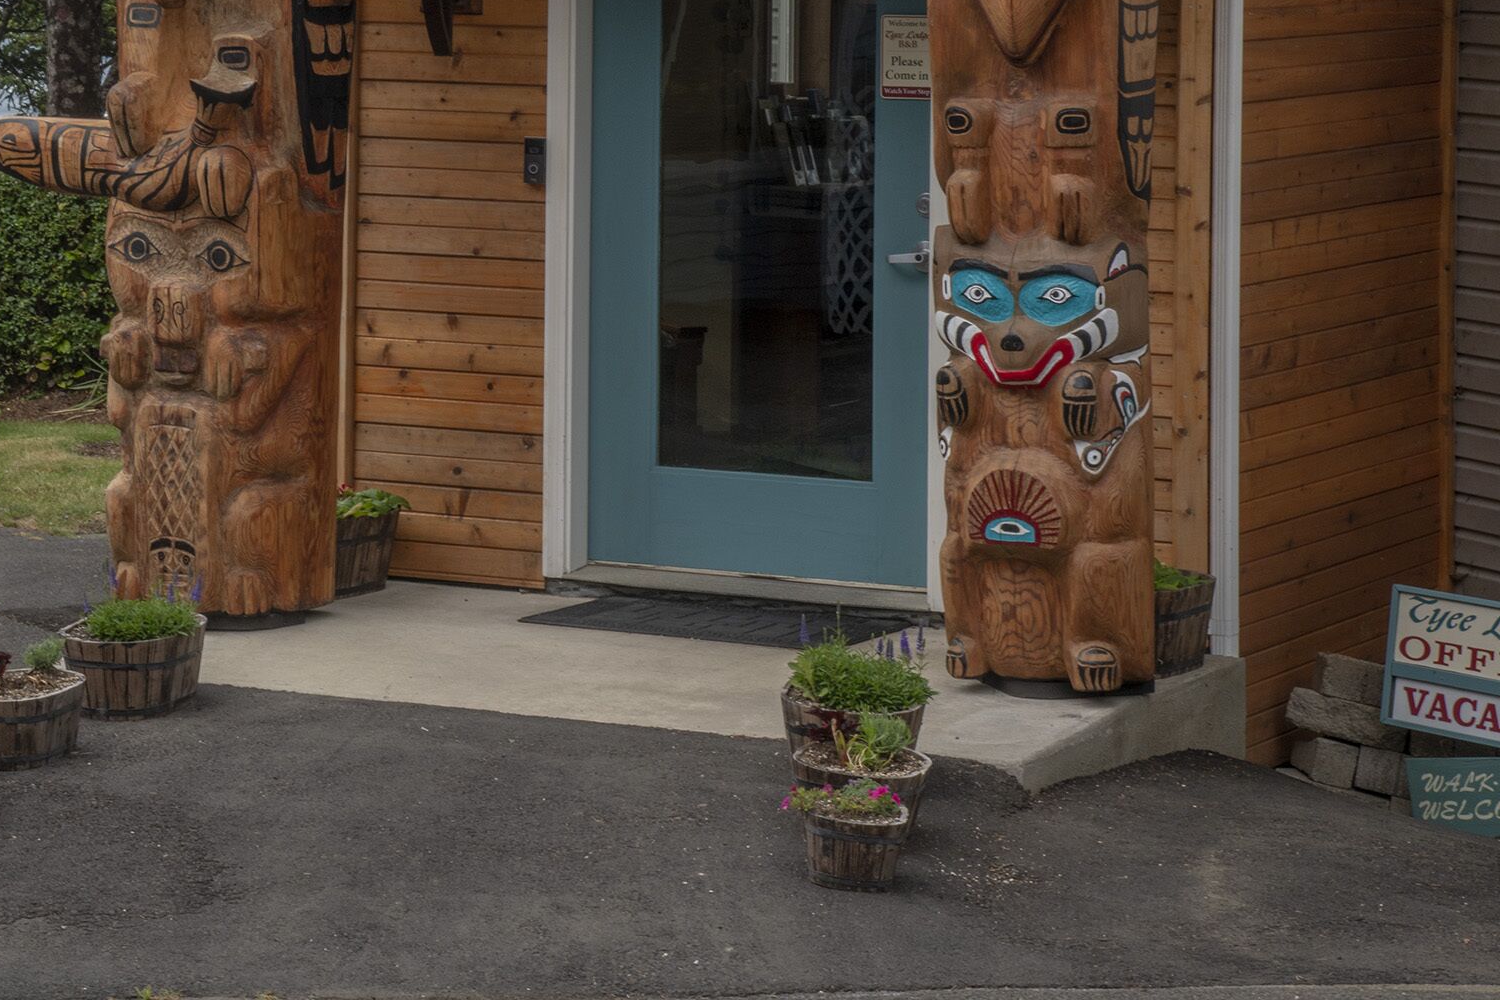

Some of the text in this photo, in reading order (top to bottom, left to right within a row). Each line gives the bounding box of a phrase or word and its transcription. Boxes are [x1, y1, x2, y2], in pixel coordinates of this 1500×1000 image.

[898, 39, 918, 49] B&B
[891, 56, 924, 67] Please
[885, 70, 929, 81] Come in
[1408, 595, 1477, 633] Tyee
[1399, 635, 1500, 677] OFF
